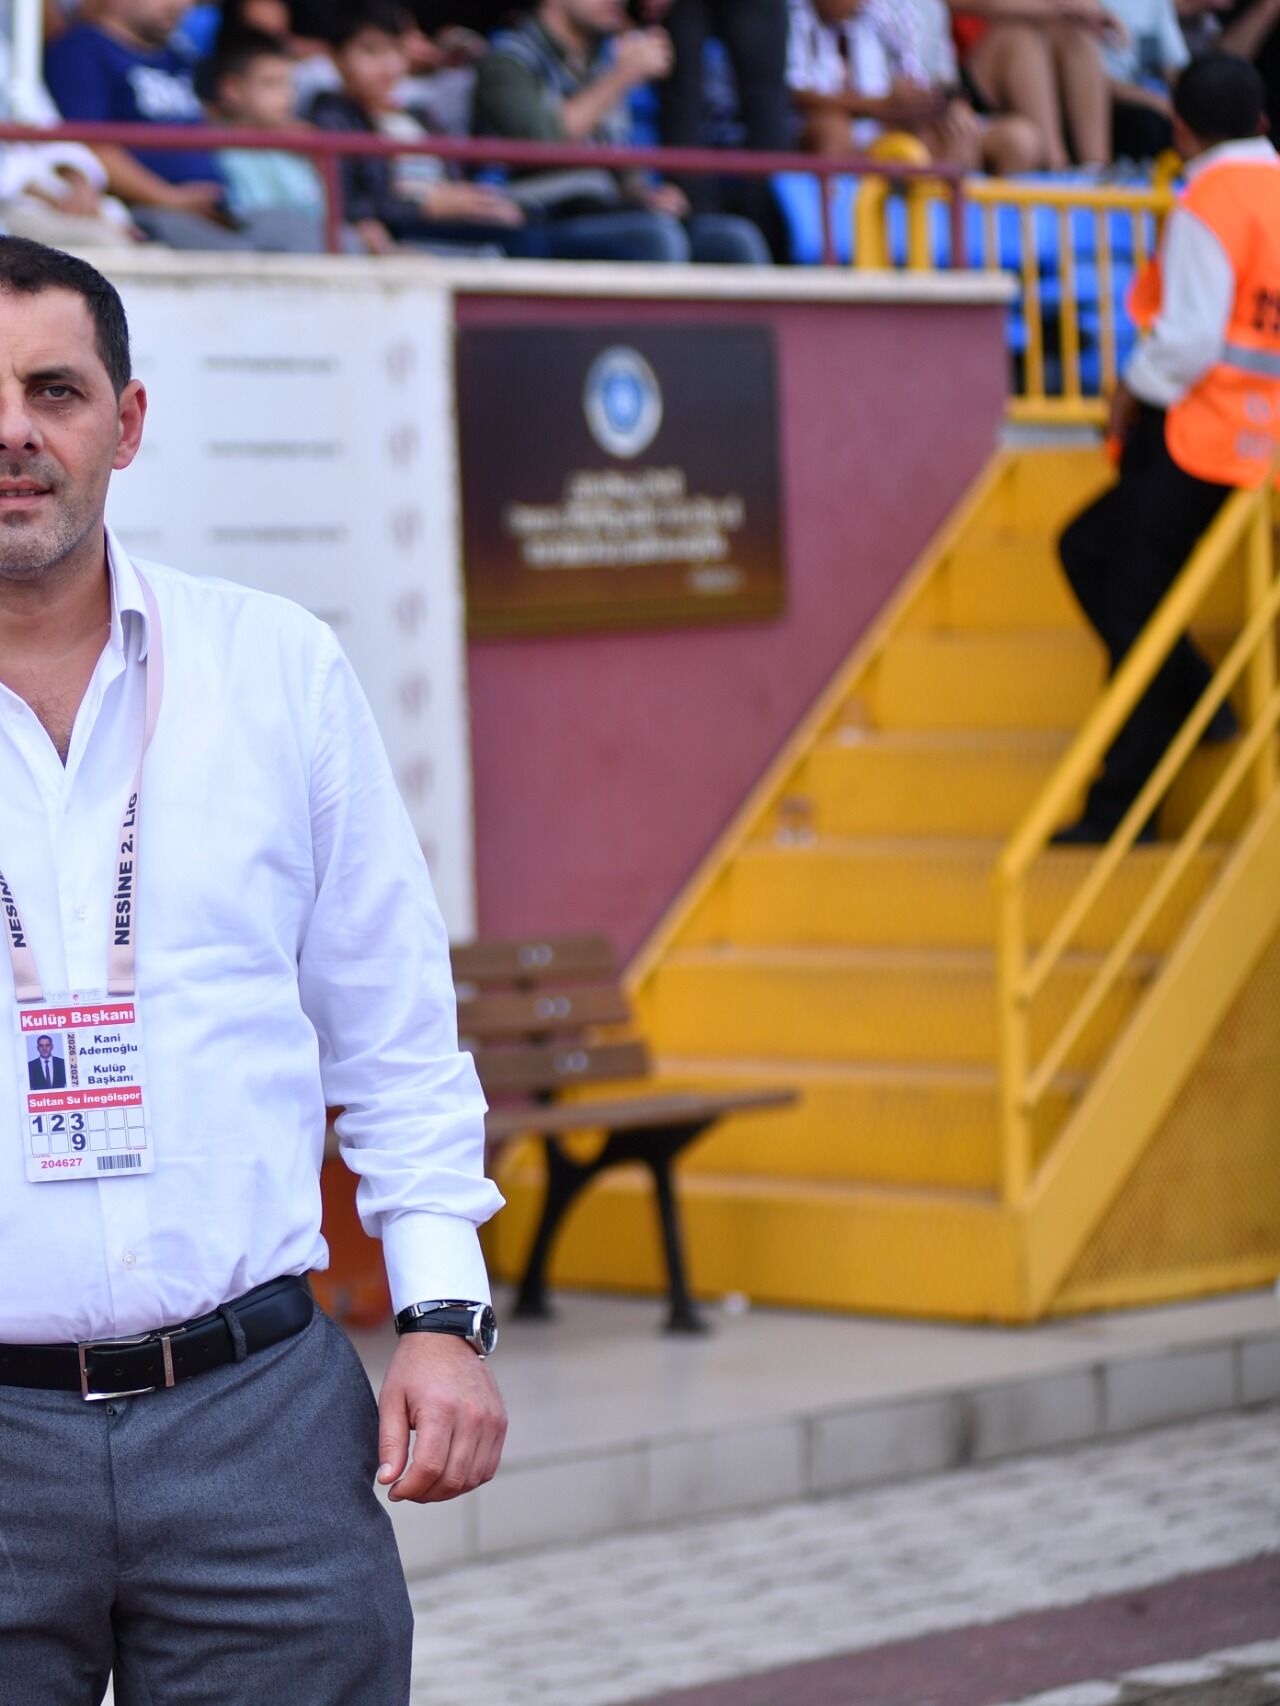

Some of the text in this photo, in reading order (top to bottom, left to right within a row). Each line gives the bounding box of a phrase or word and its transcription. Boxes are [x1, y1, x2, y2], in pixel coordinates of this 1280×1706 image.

[114, 792, 138, 946] NESİNE 2. LİG
[21, 1009, 134, 1028] Kulüp Başkanı
[94, 1033, 121, 1044] Kani
[79, 1043, 138, 1055] Ademoğlu
[93, 1064, 126, 1074] Kulüp
[87, 1074, 134, 1086] Başkanı
[29, 1092, 141, 1108] Sultan Su İnegölspor
[32, 1112, 85, 1133] 1 2 3
[71, 1132, 86, 1151] 9
[41, 1157, 83, 1170] 204627
